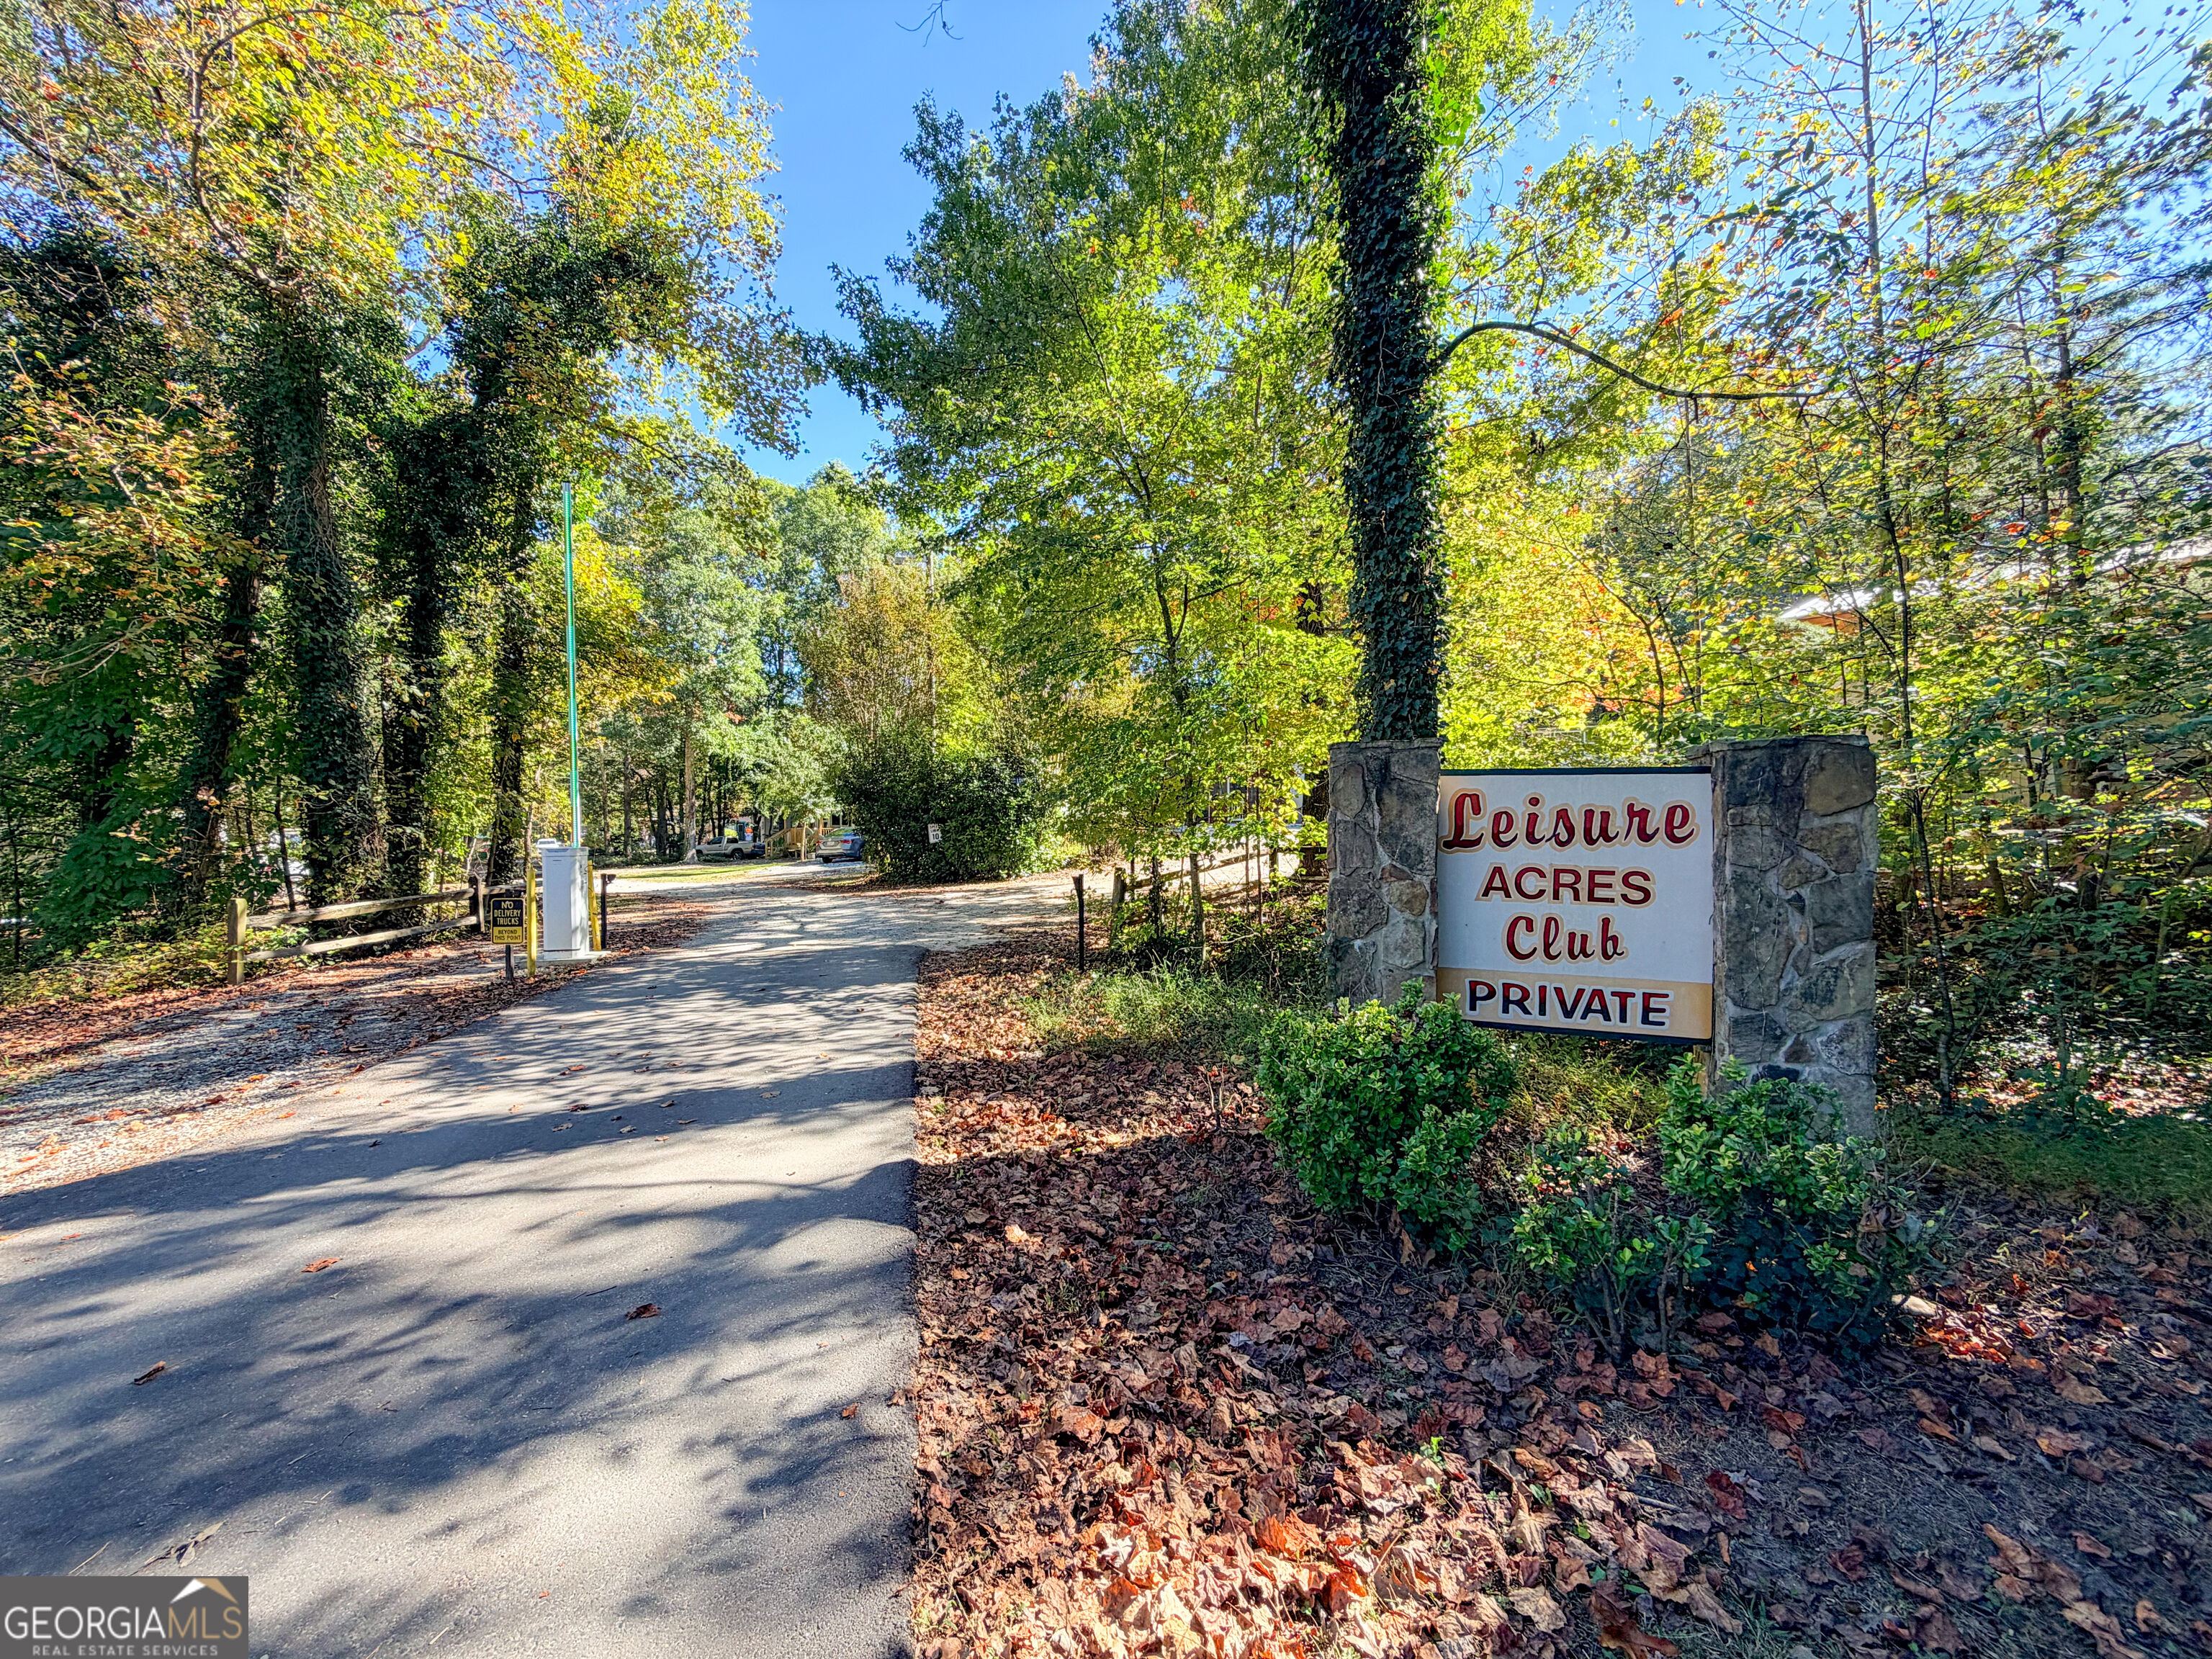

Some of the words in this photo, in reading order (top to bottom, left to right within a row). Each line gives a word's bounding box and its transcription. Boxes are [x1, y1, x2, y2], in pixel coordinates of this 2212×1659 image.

[1442, 793, 1694, 849] Leisure
[1481, 866, 1652, 904] ACRES
[1506, 916, 1625, 961] Club
[1469, 980, 1670, 1026] PRIVATE
